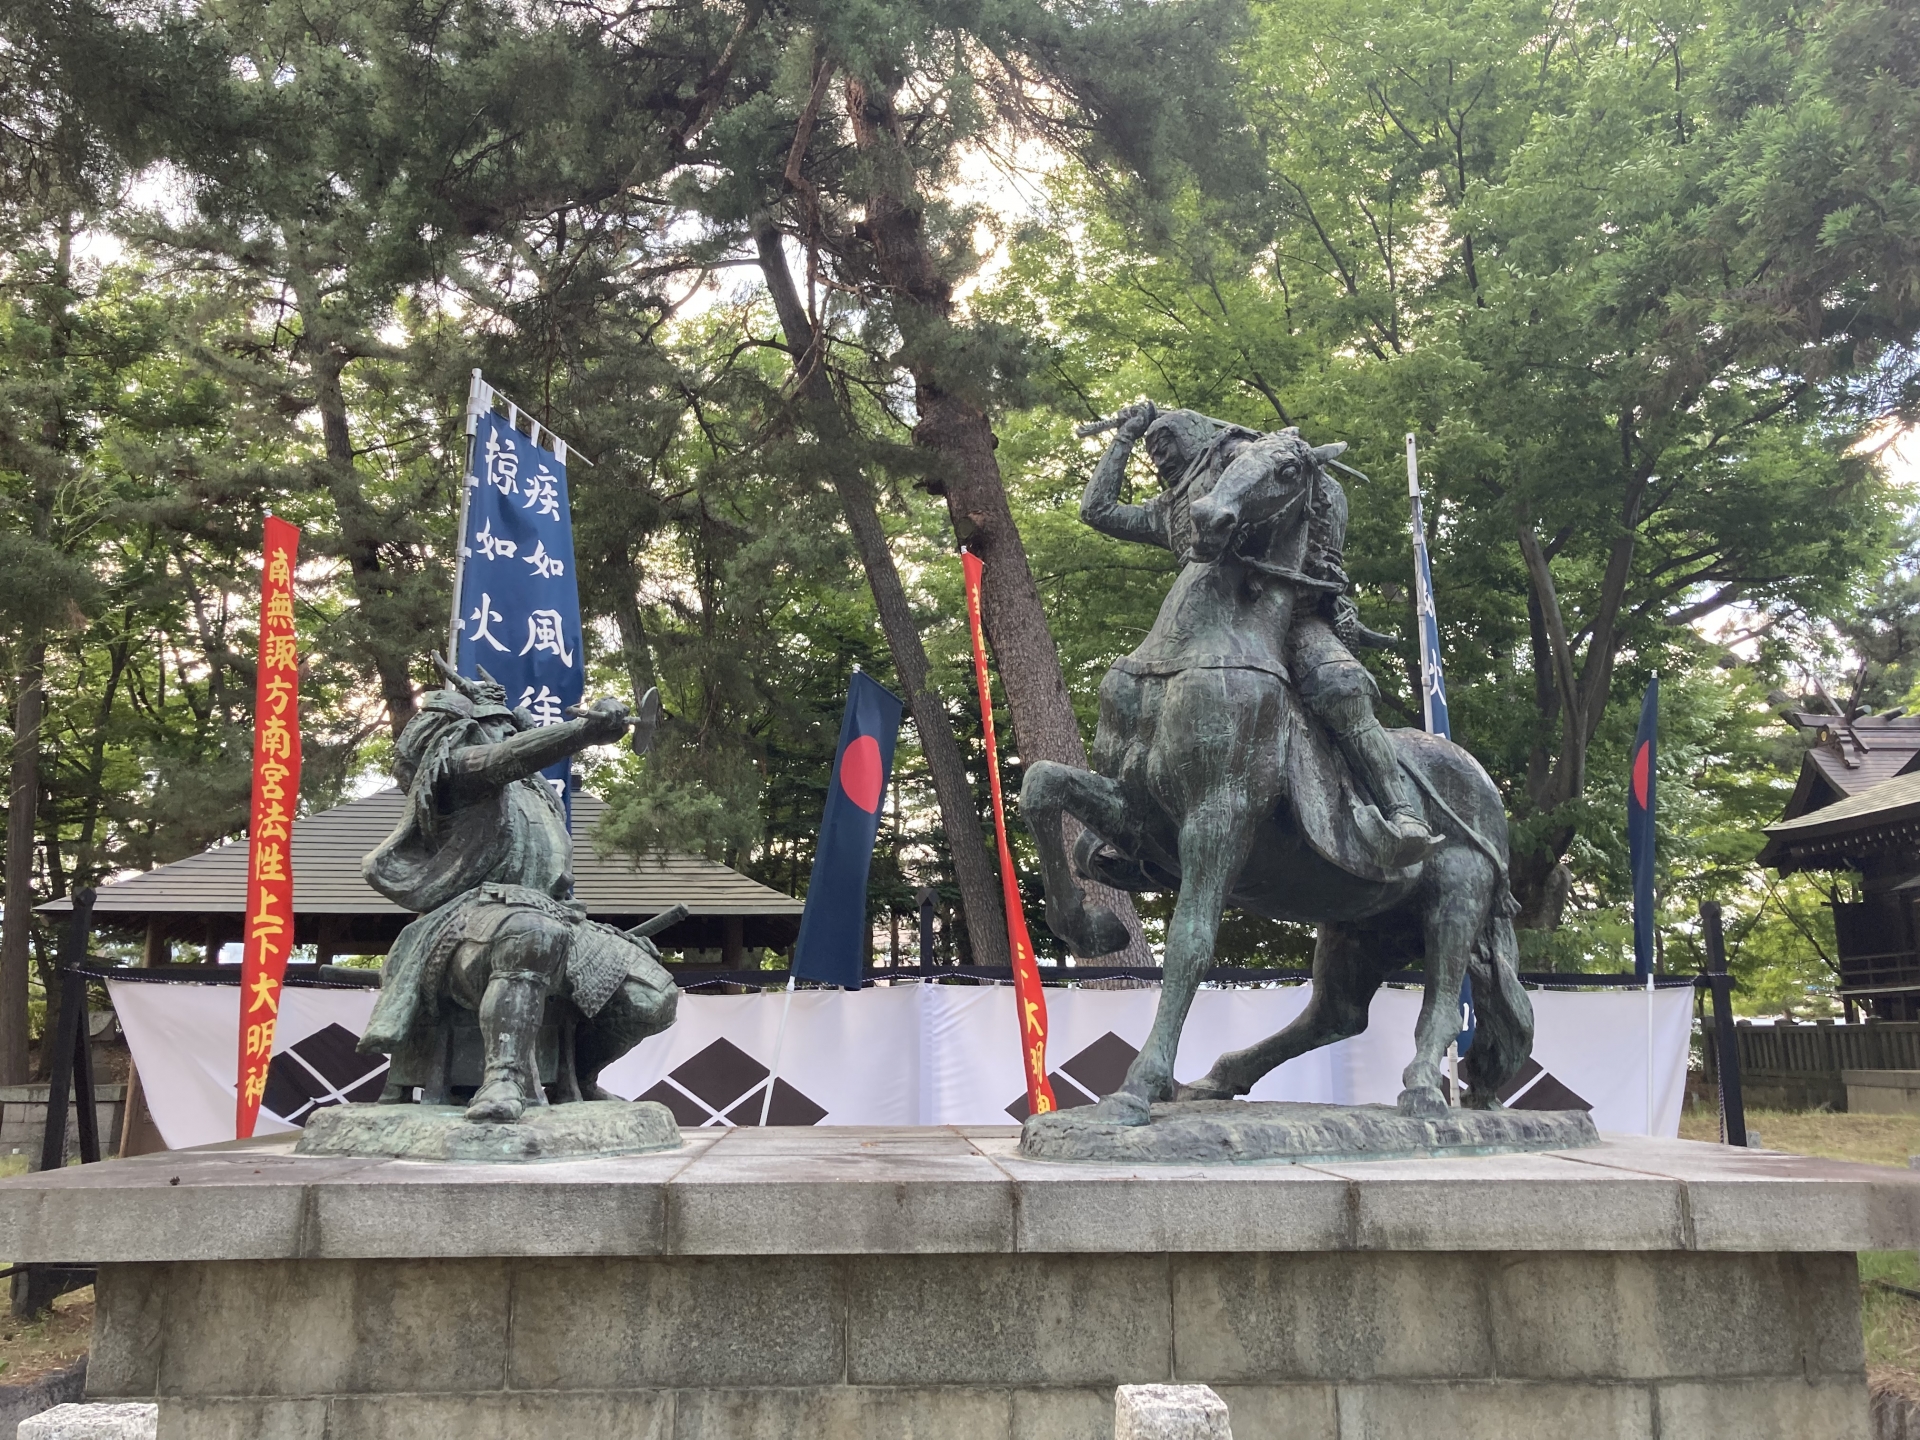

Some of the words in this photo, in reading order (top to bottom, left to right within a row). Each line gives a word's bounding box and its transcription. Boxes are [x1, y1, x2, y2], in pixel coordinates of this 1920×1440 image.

[468, 425, 519, 684] 掠如火
[518, 463, 574, 798] 疾如風徐
[245, 547, 297, 1107] 南無諏方南宮法性上下大明神
